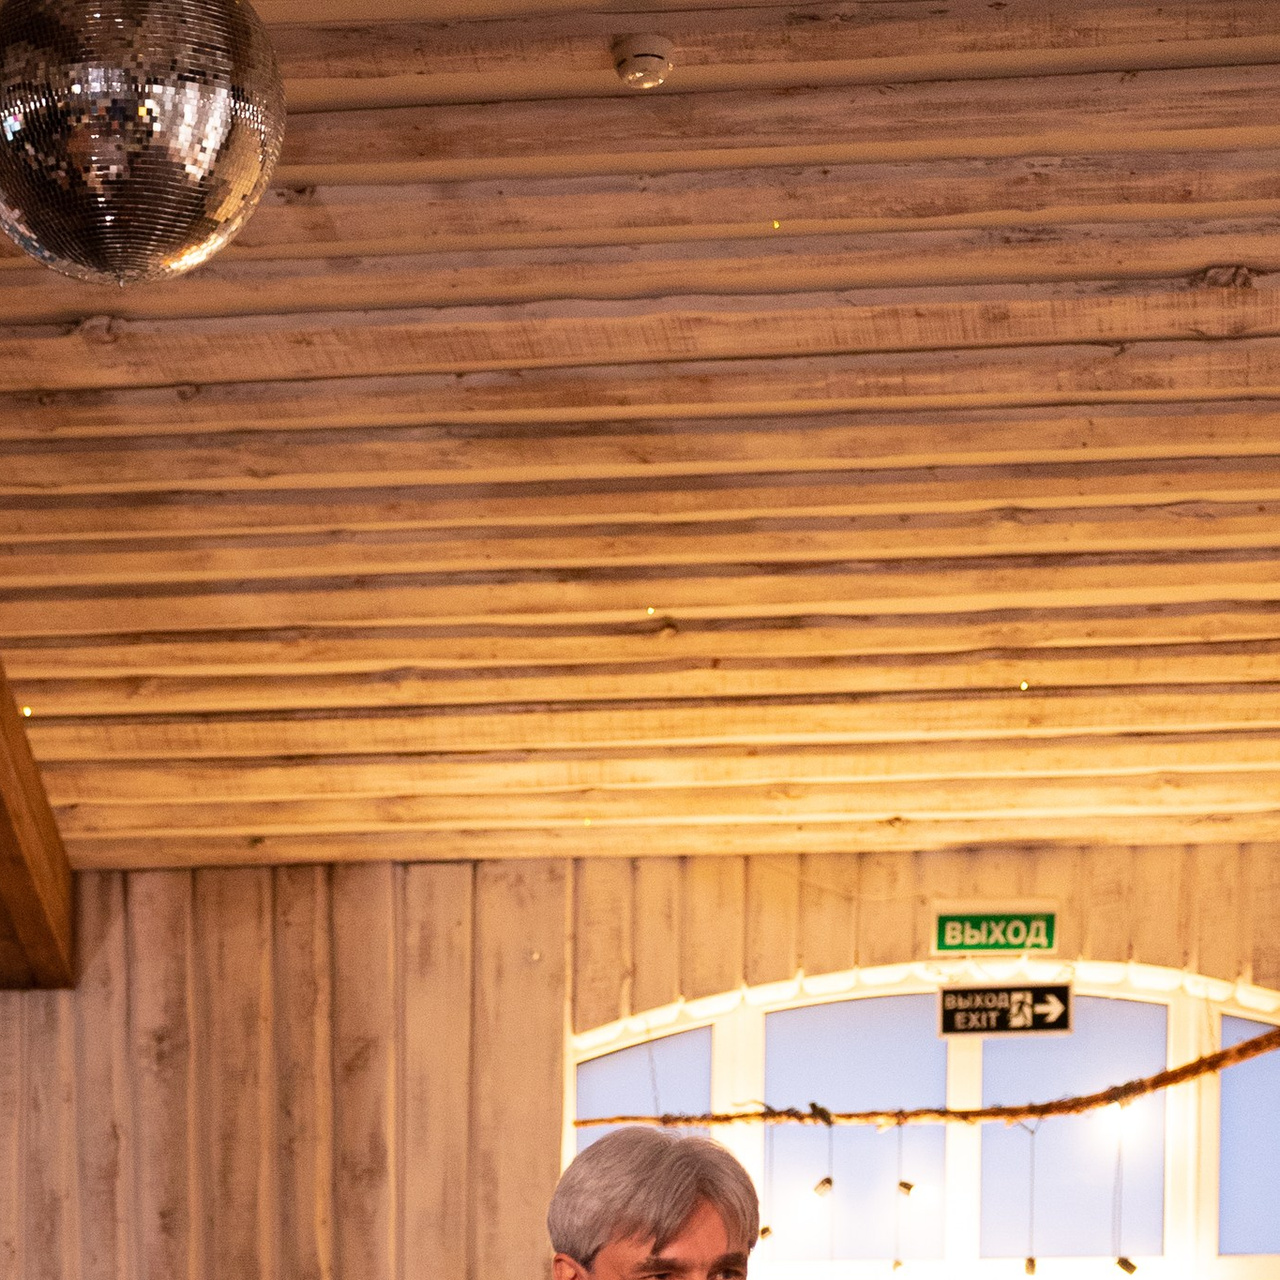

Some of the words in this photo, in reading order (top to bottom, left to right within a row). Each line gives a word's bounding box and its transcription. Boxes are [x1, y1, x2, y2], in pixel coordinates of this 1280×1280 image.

[944, 920, 1048, 948] ВЫХОД
[945, 992, 1009, 1010] ВЫХОД
[954, 1011, 999, 1029] EXIT
